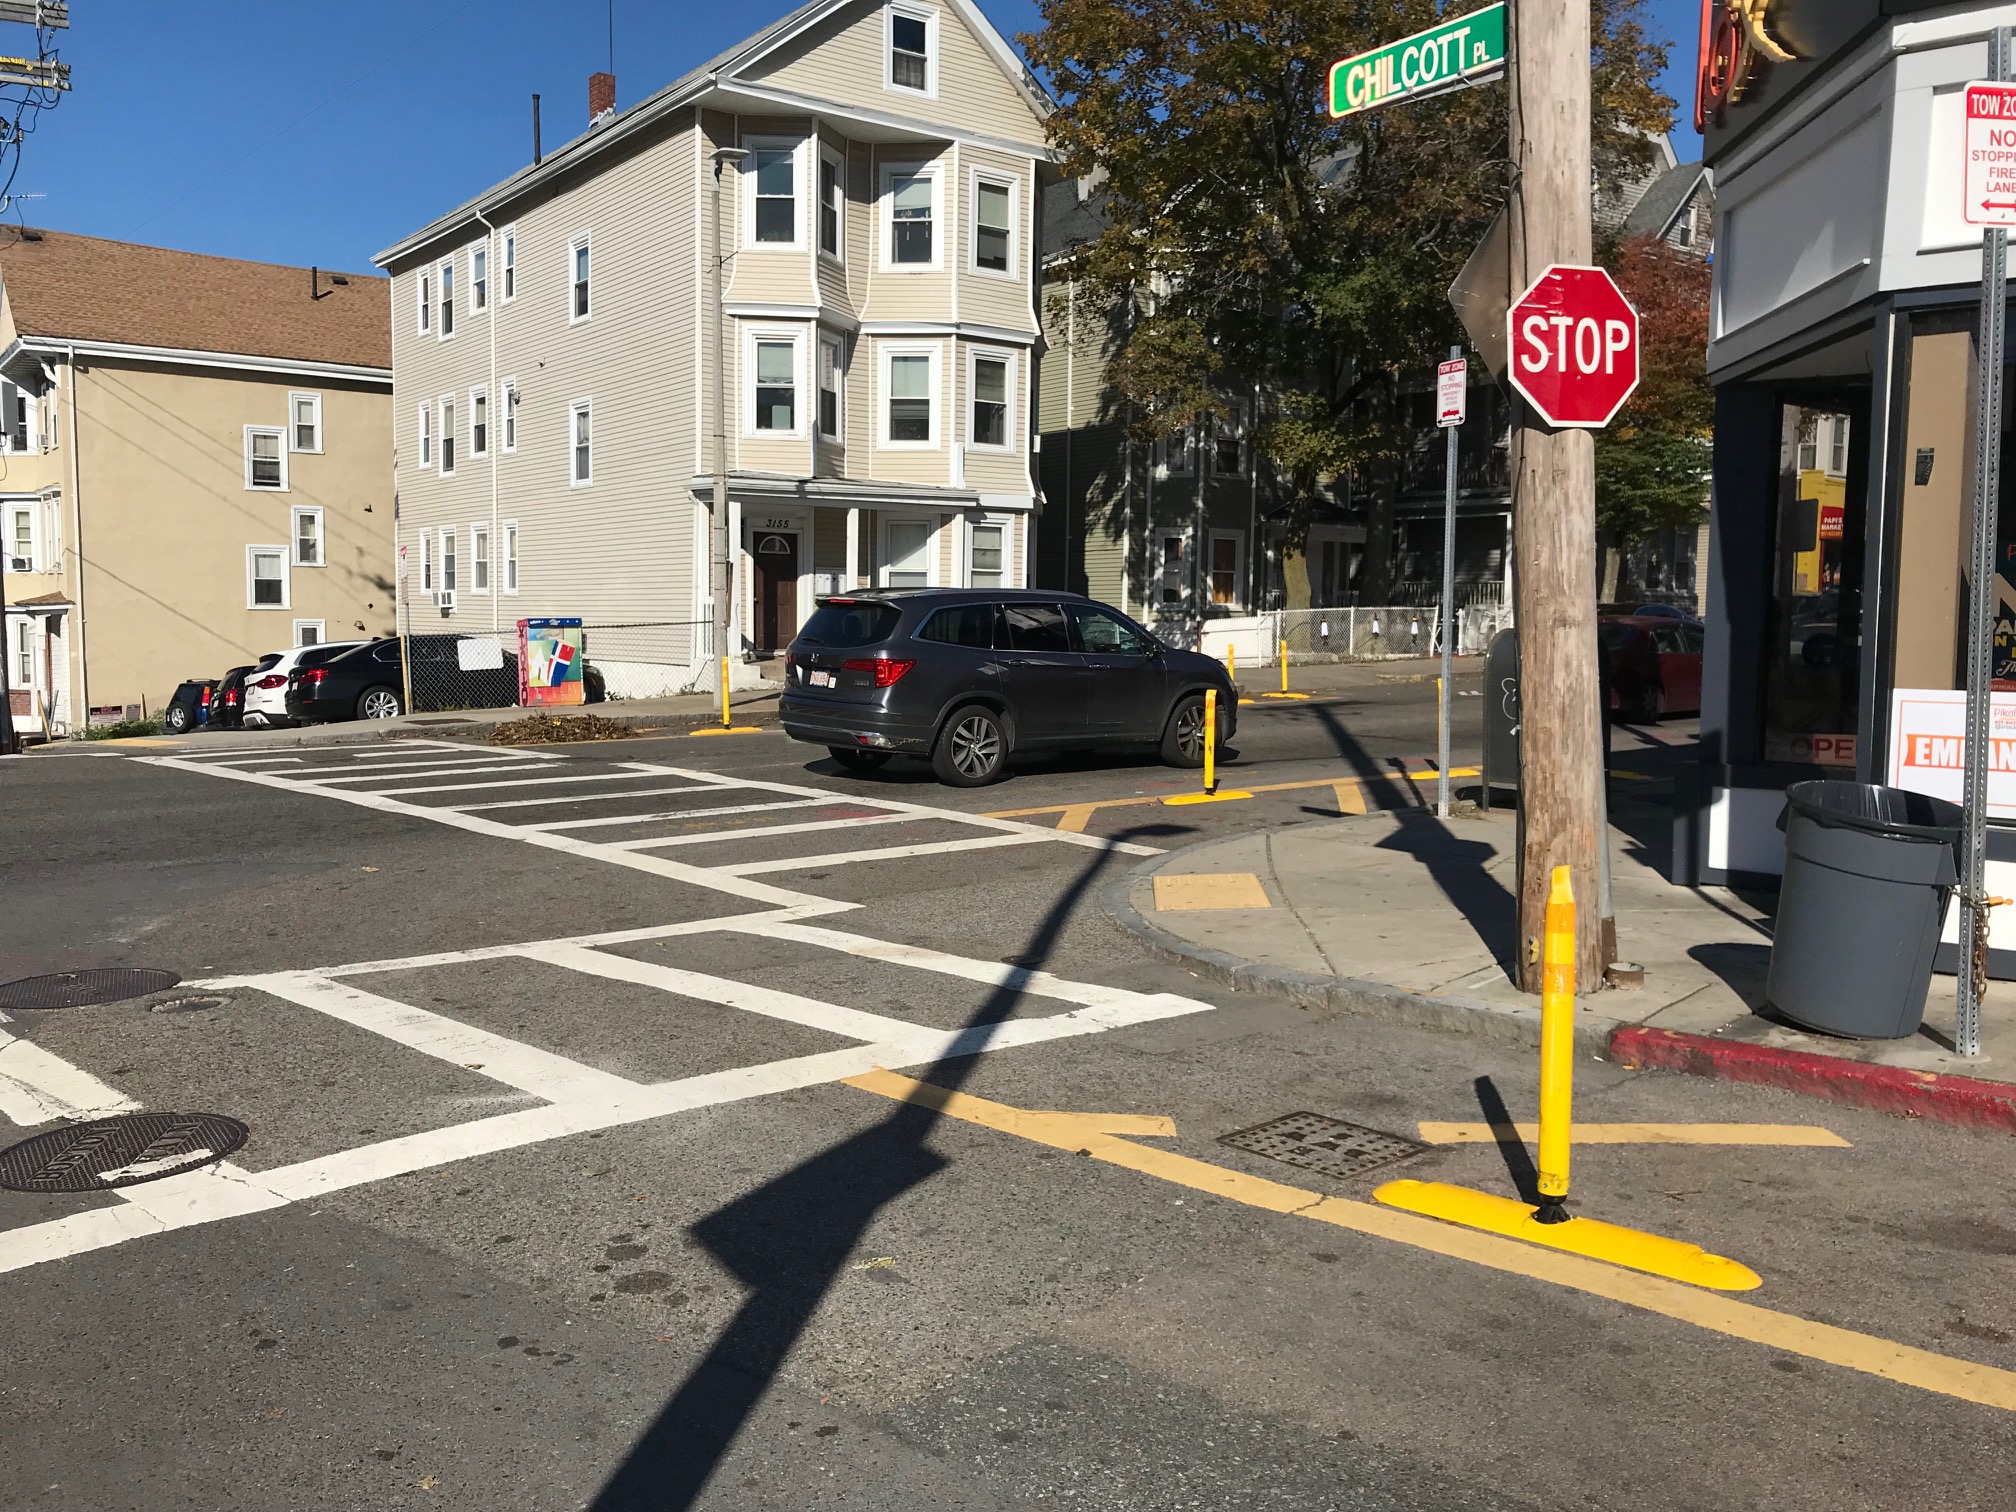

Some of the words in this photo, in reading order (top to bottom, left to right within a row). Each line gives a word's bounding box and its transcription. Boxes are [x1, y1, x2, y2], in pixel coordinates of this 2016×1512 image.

[1346, 26, 1471, 107] CHILCOTT
[1473, 40, 1490, 64] PL
[1972, 94, 2000, 115] TOW
[1990, 129, 2016, 147] NO
[1989, 167, 2016, 178] FIRE
[1986, 181, 2016, 193] LANE
[1520, 315, 1630, 374] STOP
[1440, 365, 1450, 374] TOW
[1451, 361, 1465, 372] ZONE
[1441, 382, 1462, 391] STOPPING
[766, 518, 789, 528] 3155
[1789, 738, 1858, 760] OPE
